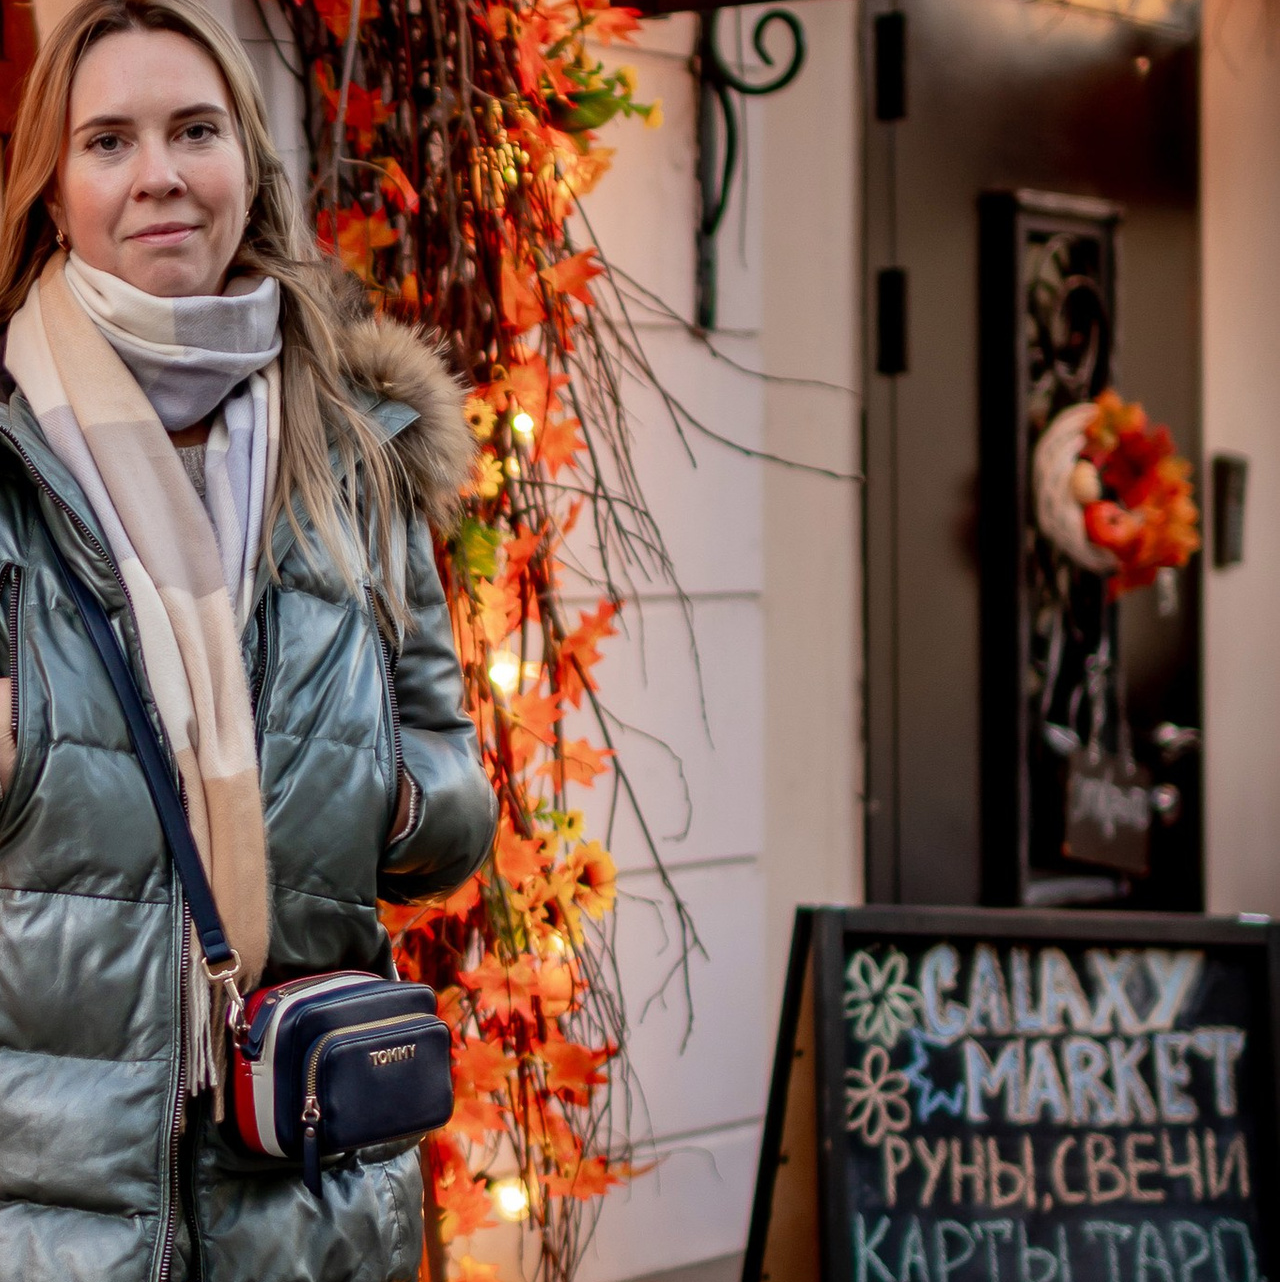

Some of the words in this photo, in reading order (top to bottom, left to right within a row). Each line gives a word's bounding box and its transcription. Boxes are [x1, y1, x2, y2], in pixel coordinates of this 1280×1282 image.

[920, 941, 1206, 1047] GALAXY
[369, 1043, 417, 1066] TOMMY
[963, 1026, 1247, 1124] MARKET
